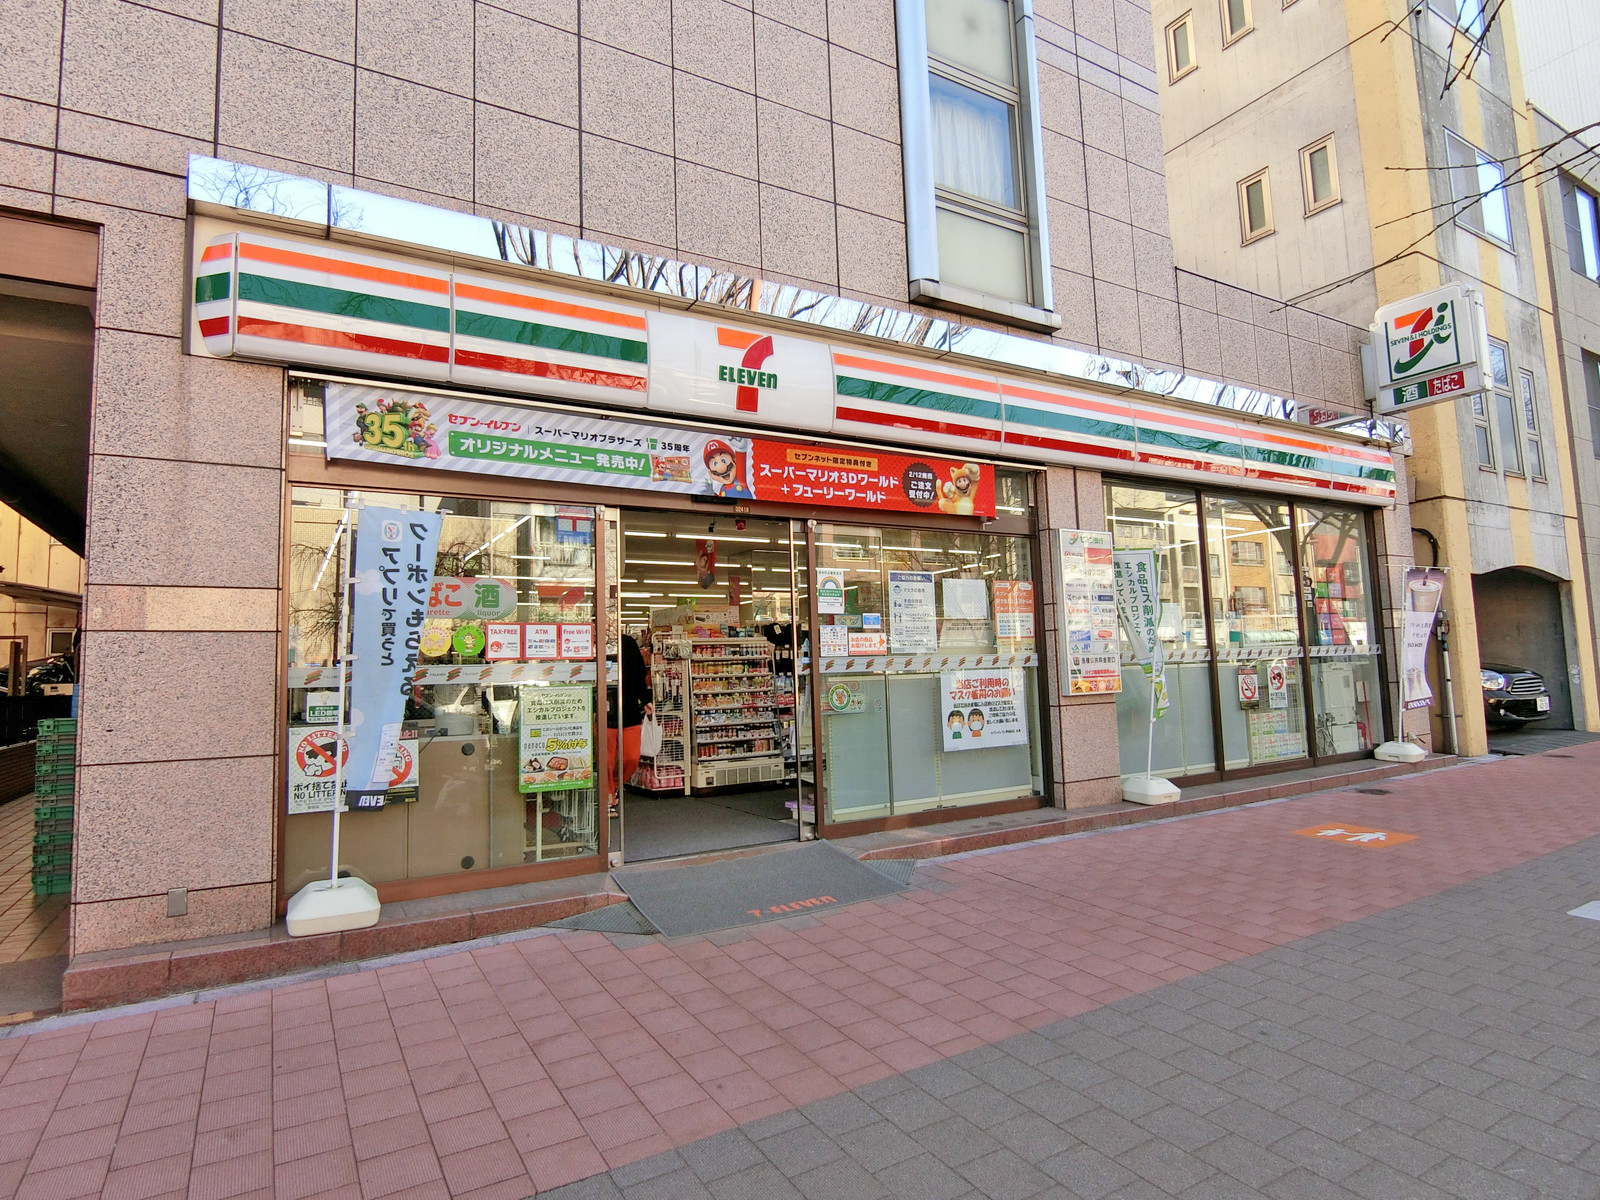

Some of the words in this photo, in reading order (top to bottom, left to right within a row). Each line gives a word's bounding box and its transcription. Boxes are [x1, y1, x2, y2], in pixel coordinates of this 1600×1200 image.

[1418, 322, 1452, 340] HOLDINGS
[1432, 375, 1461, 395] たばこ
[1402, 385, 1419, 403] 酒
[533, 425, 643, 447] スーパーマリオブラザーズ
[459, 437, 647, 471] オリジナルメニュー発売中!
[660, 440, 691, 454] 35周年
[792, 452, 873, 468] セブンネット限定特典付き
[758, 463, 900, 488] スーパーマリオ3Dワールド
[910, 480, 932, 491] ご注文
[428, 582, 463, 608] ばこ
[474, 583, 500, 609] 酒
[477, 609, 501, 617] liquor
[955, 677, 1010, 690] 当店ご利用時の
[949, 687, 1016, 700] マスク着用のお願い
[527, 705, 586, 713] エシカルプロジェクトを
[298, 741, 308, 753] NO
[293, 791, 306, 800] NO
